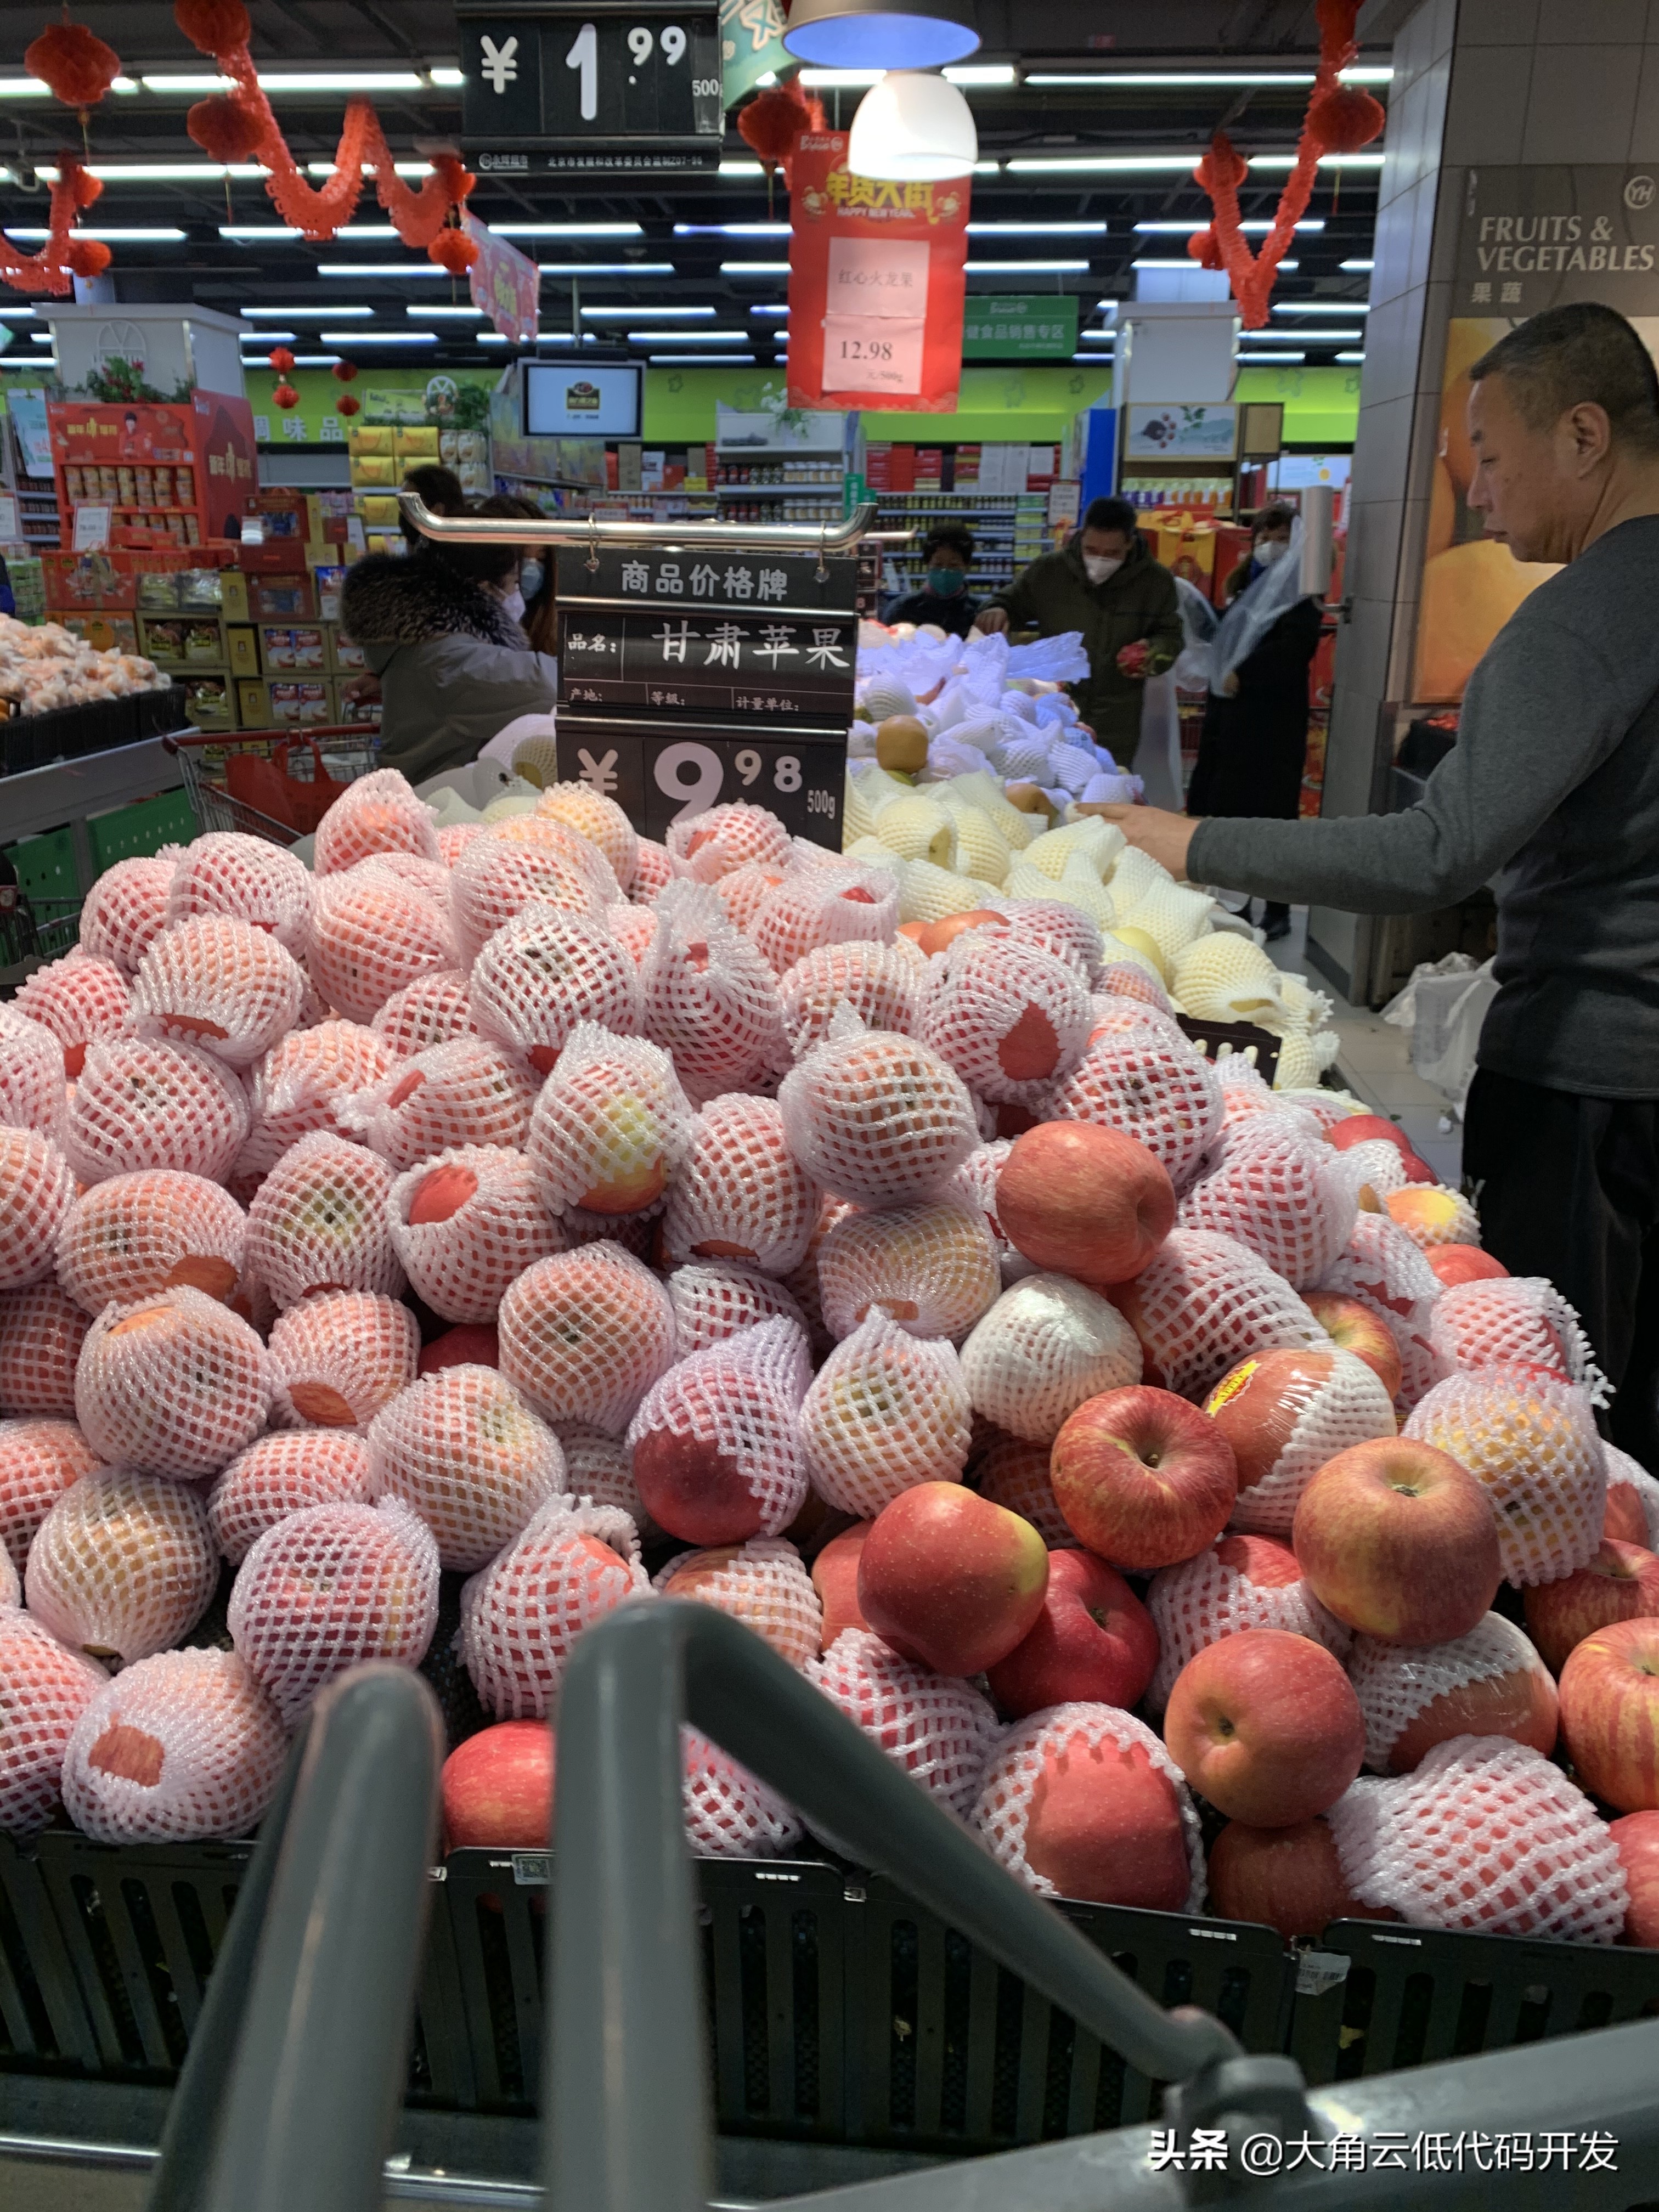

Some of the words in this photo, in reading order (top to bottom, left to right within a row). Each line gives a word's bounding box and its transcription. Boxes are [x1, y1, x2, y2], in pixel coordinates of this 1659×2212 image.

[1480, 216, 1582, 241] FRUITS
[1590, 216, 1613, 241] &
[1477, 245, 1656, 272] VEGETABLES
[838, 269, 913, 287] 红心火龙果
[1471, 281, 1522, 303] 果蔬
[840, 340, 893, 360] 12.98
[621, 560, 787, 601] 商品价格牌
[651, 620, 850, 670] 甘肃苹果
[807, 789, 835, 819] 500g
